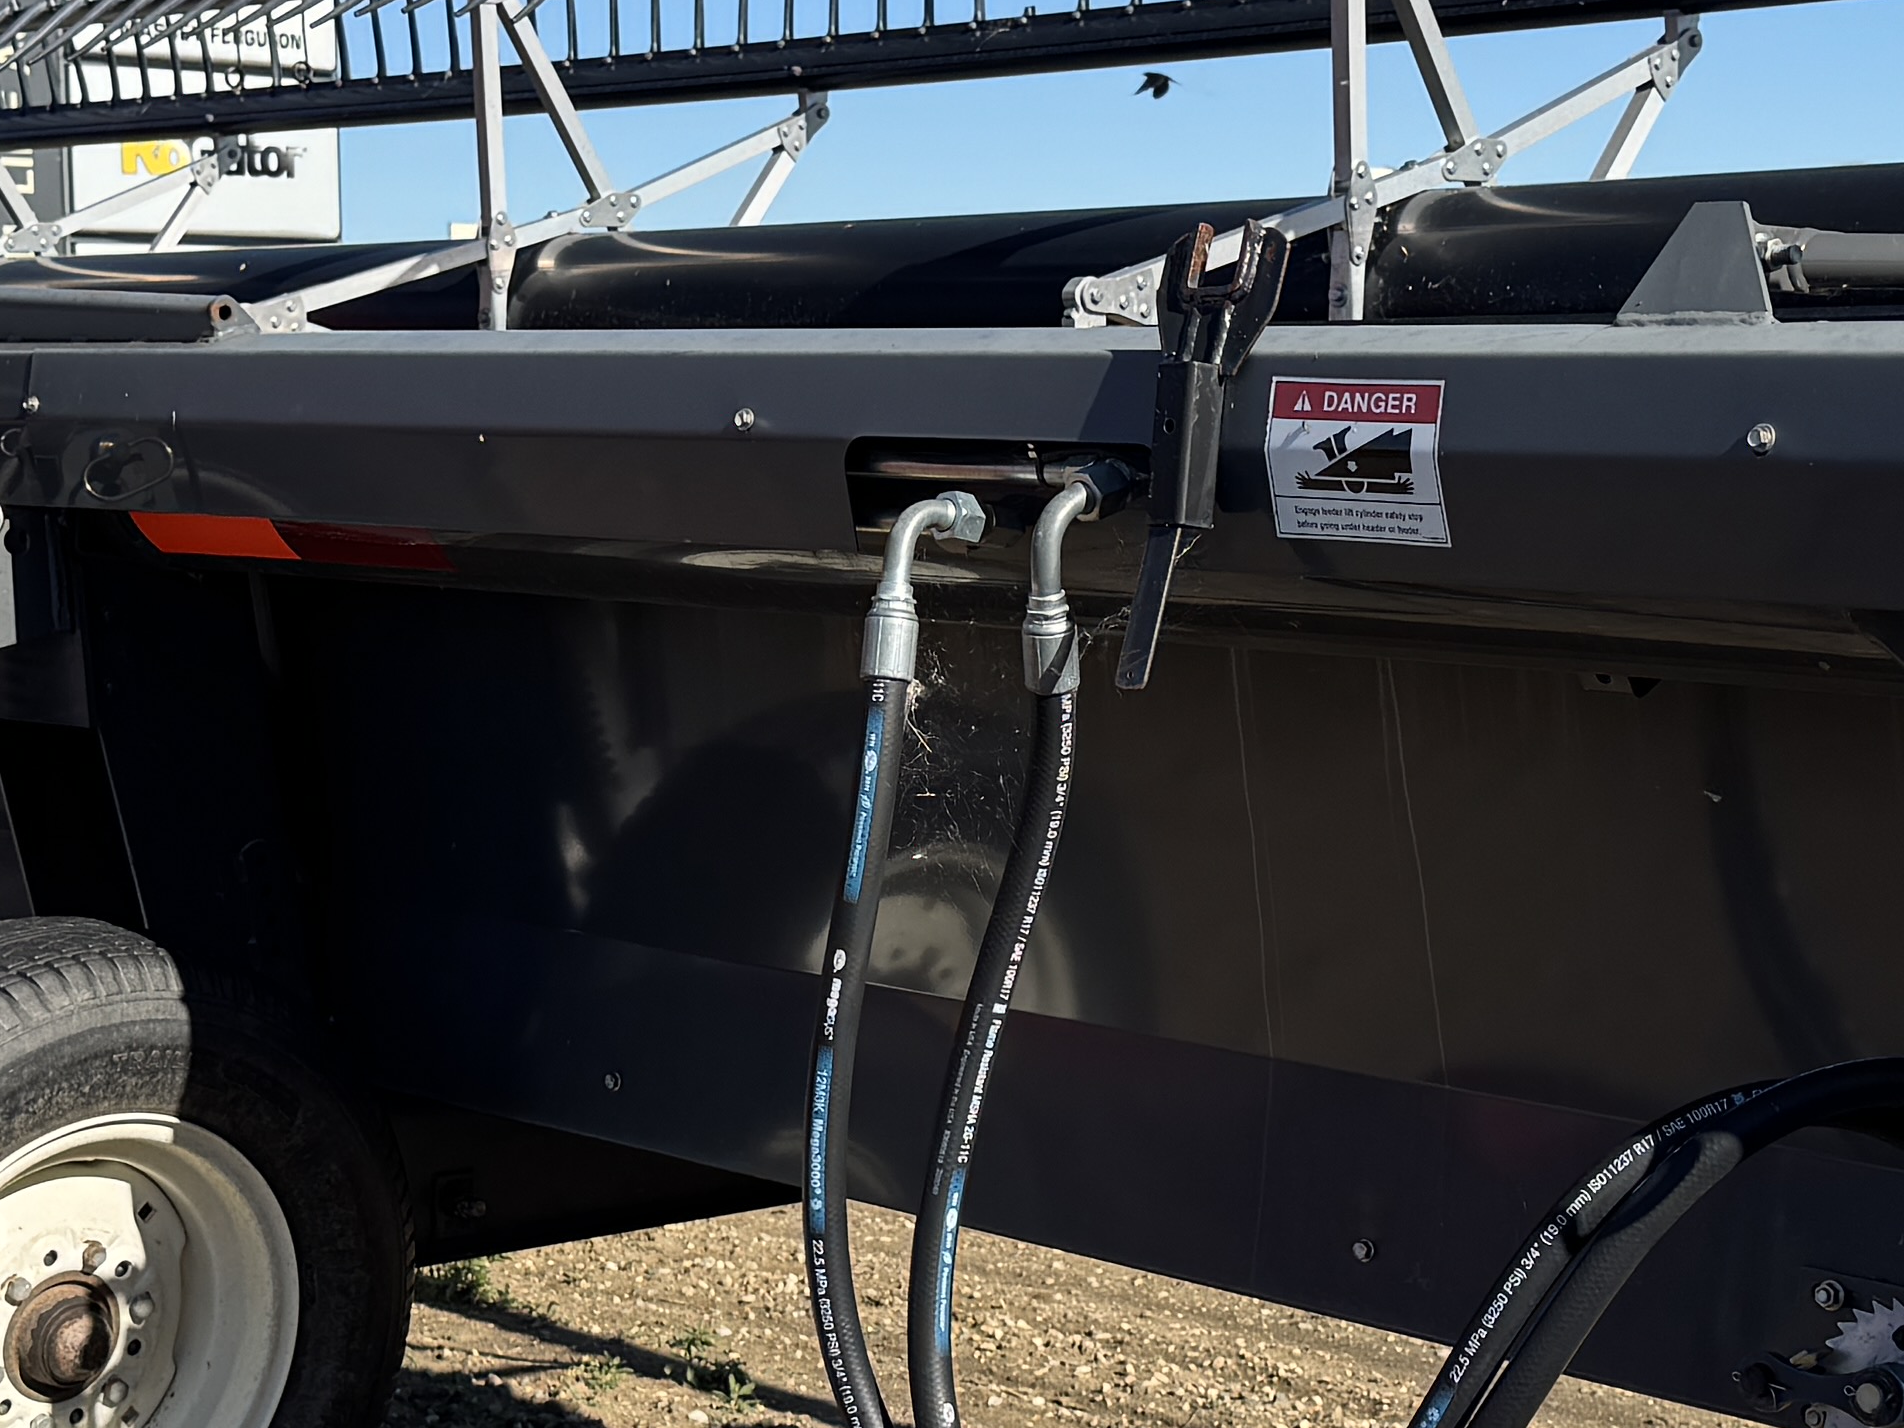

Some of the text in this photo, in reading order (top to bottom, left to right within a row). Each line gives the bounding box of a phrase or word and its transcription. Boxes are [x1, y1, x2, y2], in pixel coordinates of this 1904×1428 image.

[1323, 391, 1417, 414] DANGER
[1449, 1354, 1470, 1384] 22.5
[1464, 1327, 1488, 1357] MPa
[1481, 1292, 1509, 1329] (3250
[1503, 1267, 1528, 1295] PSI)
[1539, 1214, 1567, 1246] (19.0
[1565, 1189, 1592, 1217] mm)
[1587, 1149, 1635, 1194] ISO11237
[1632, 1133, 1656, 1157] R17
[1662, 1118, 1687, 1138] SAE
